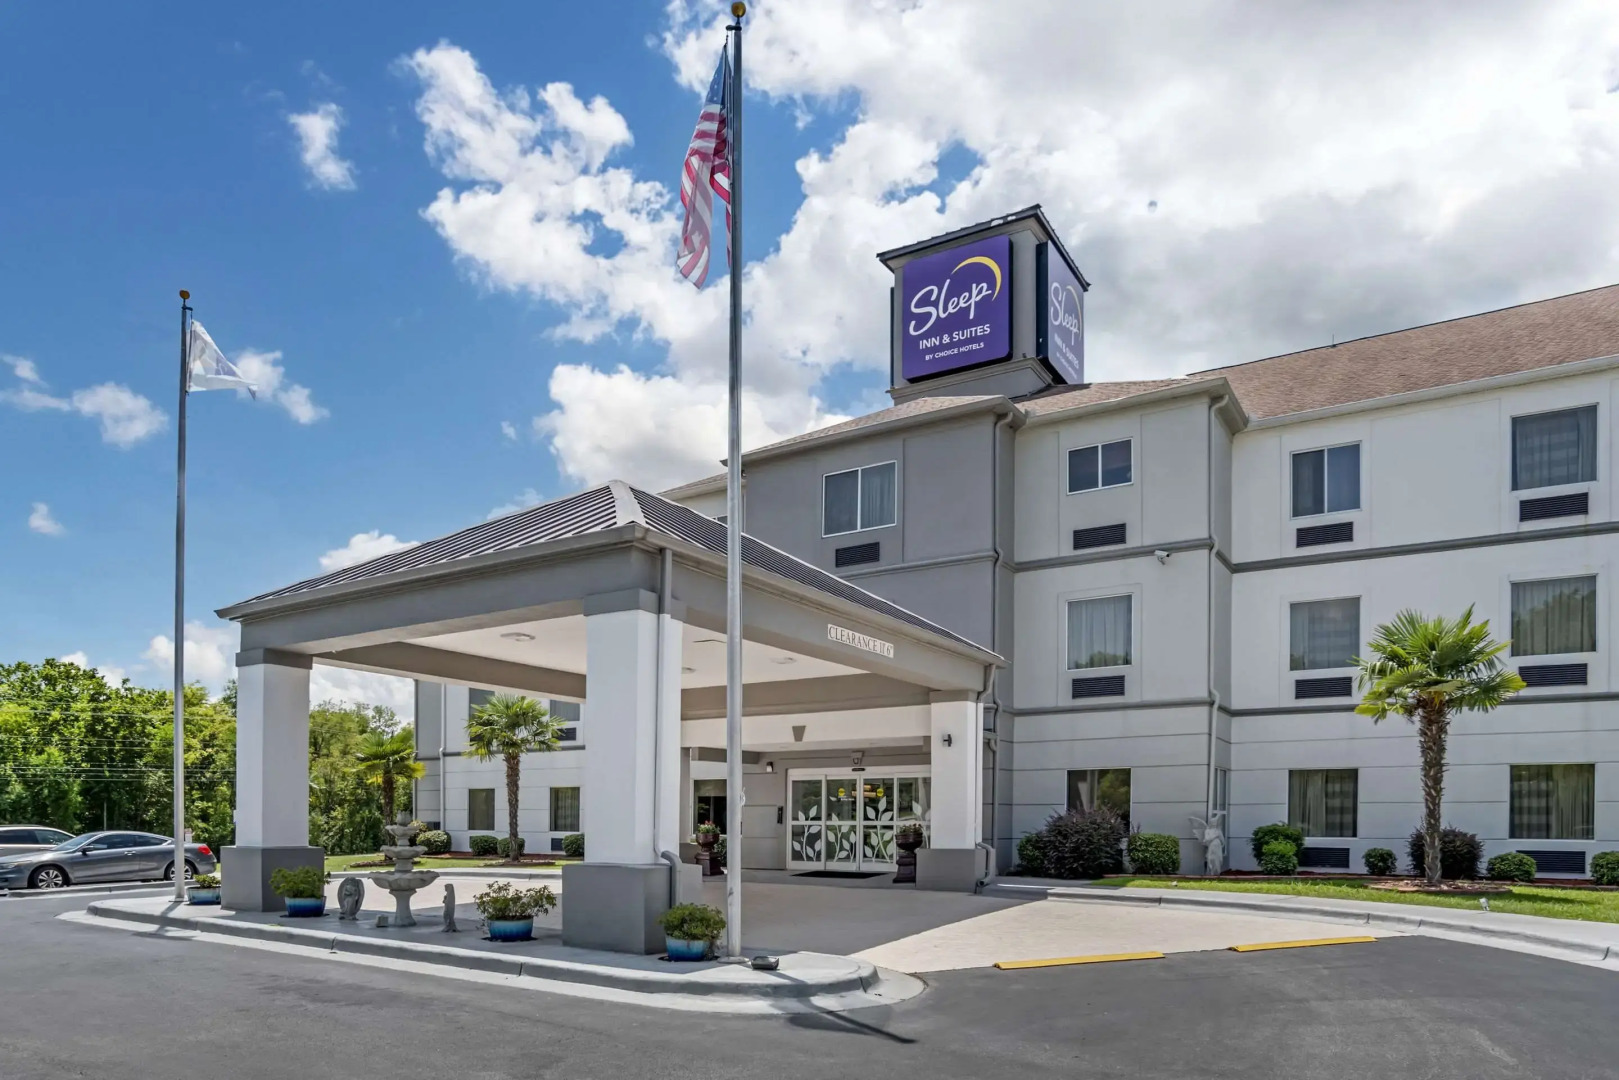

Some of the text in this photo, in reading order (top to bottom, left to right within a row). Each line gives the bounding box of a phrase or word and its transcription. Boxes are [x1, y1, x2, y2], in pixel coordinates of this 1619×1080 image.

[909, 279, 992, 336] Sleep
[1050, 282, 1080, 346] Sleep
[919, 324, 991, 350] INN & SUITES
[934, 348, 959, 359] CHOICE
[959, 342, 985, 353] HOTELS
[828, 625, 878, 652] CLEARANCE
